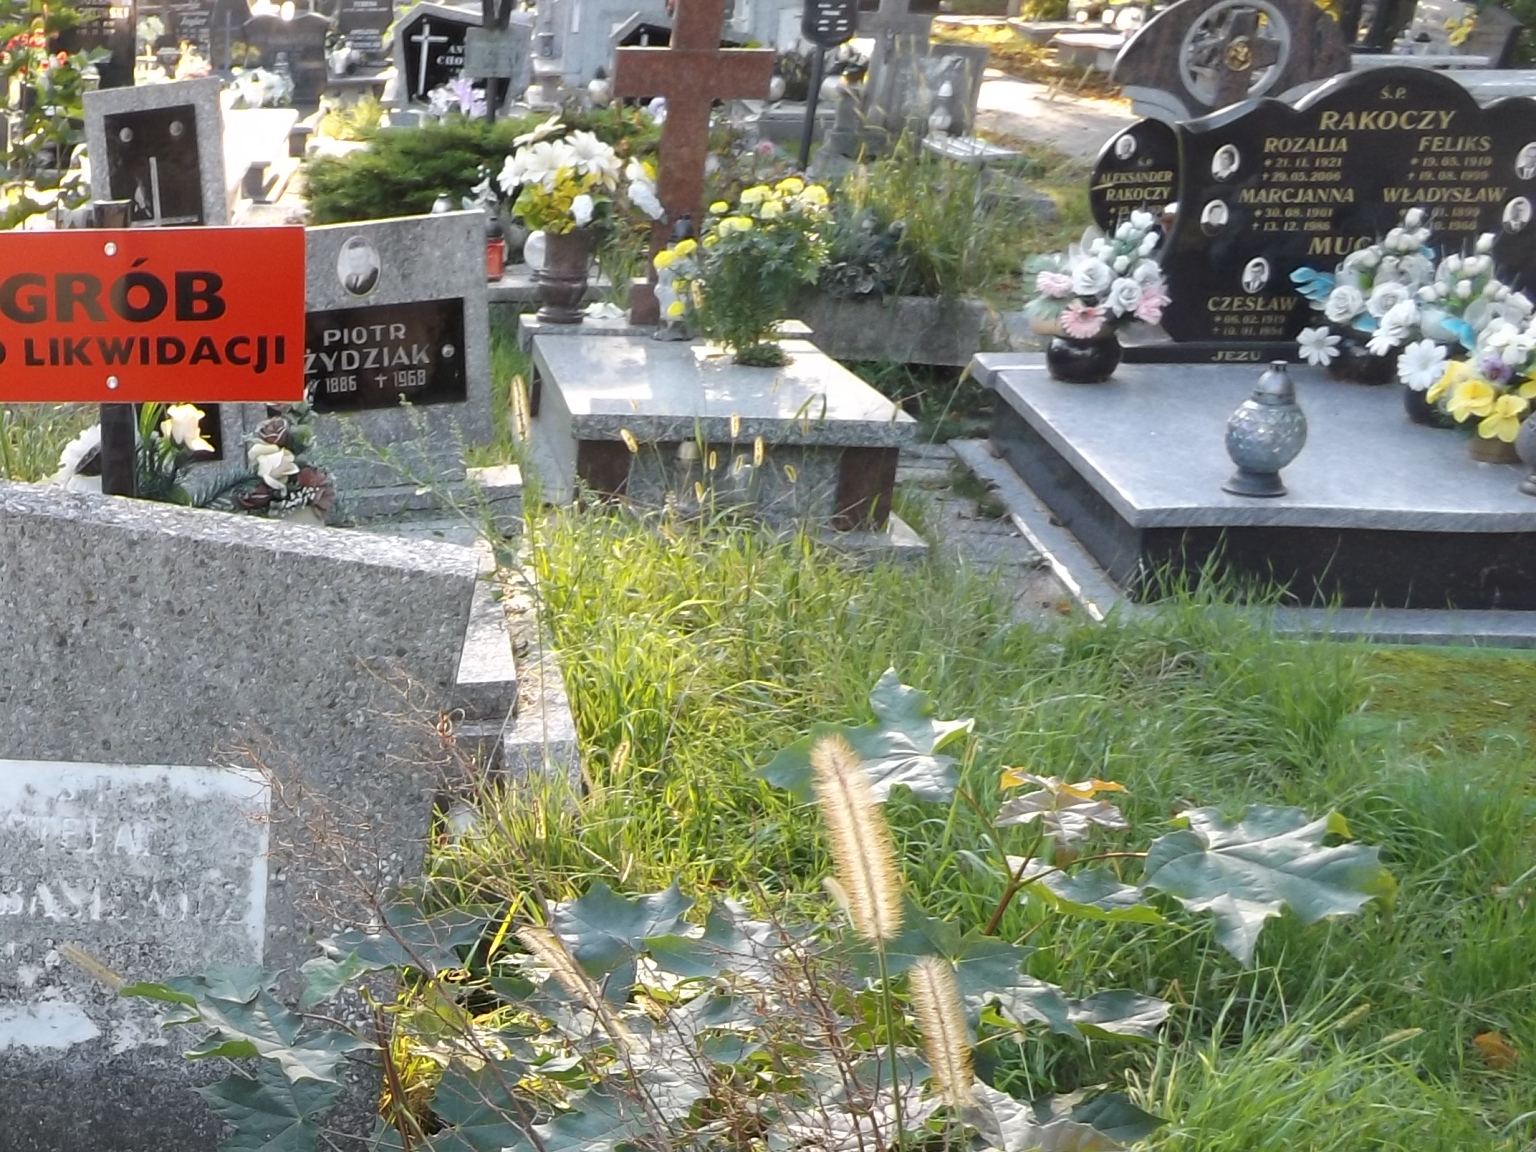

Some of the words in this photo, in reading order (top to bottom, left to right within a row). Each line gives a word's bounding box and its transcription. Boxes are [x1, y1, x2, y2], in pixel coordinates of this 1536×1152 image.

[1319, 110, 1457, 131] RAKOCZY
[1264, 137, 1348, 152] ROZALIA
[1418, 136, 1491, 152] FELIKS
[1100, 170, 1173, 184] ALEKSANDER
[1106, 187, 1171, 201] RAKOCZY
[1239, 188, 1355, 203] MARCJANNA
[1383, 187, 1506, 203] WŁADYSŁAW
[1207, 296, 1297, 311] CZESŁAW
[323, 323, 406, 347] PIOTR
[24, 334, 286, 374] LIKWIDACJI
[1211, 351, 1261, 361] JEZU
[325, 375, 357, 393] 1886
[393, 369, 427, 388] 1968
